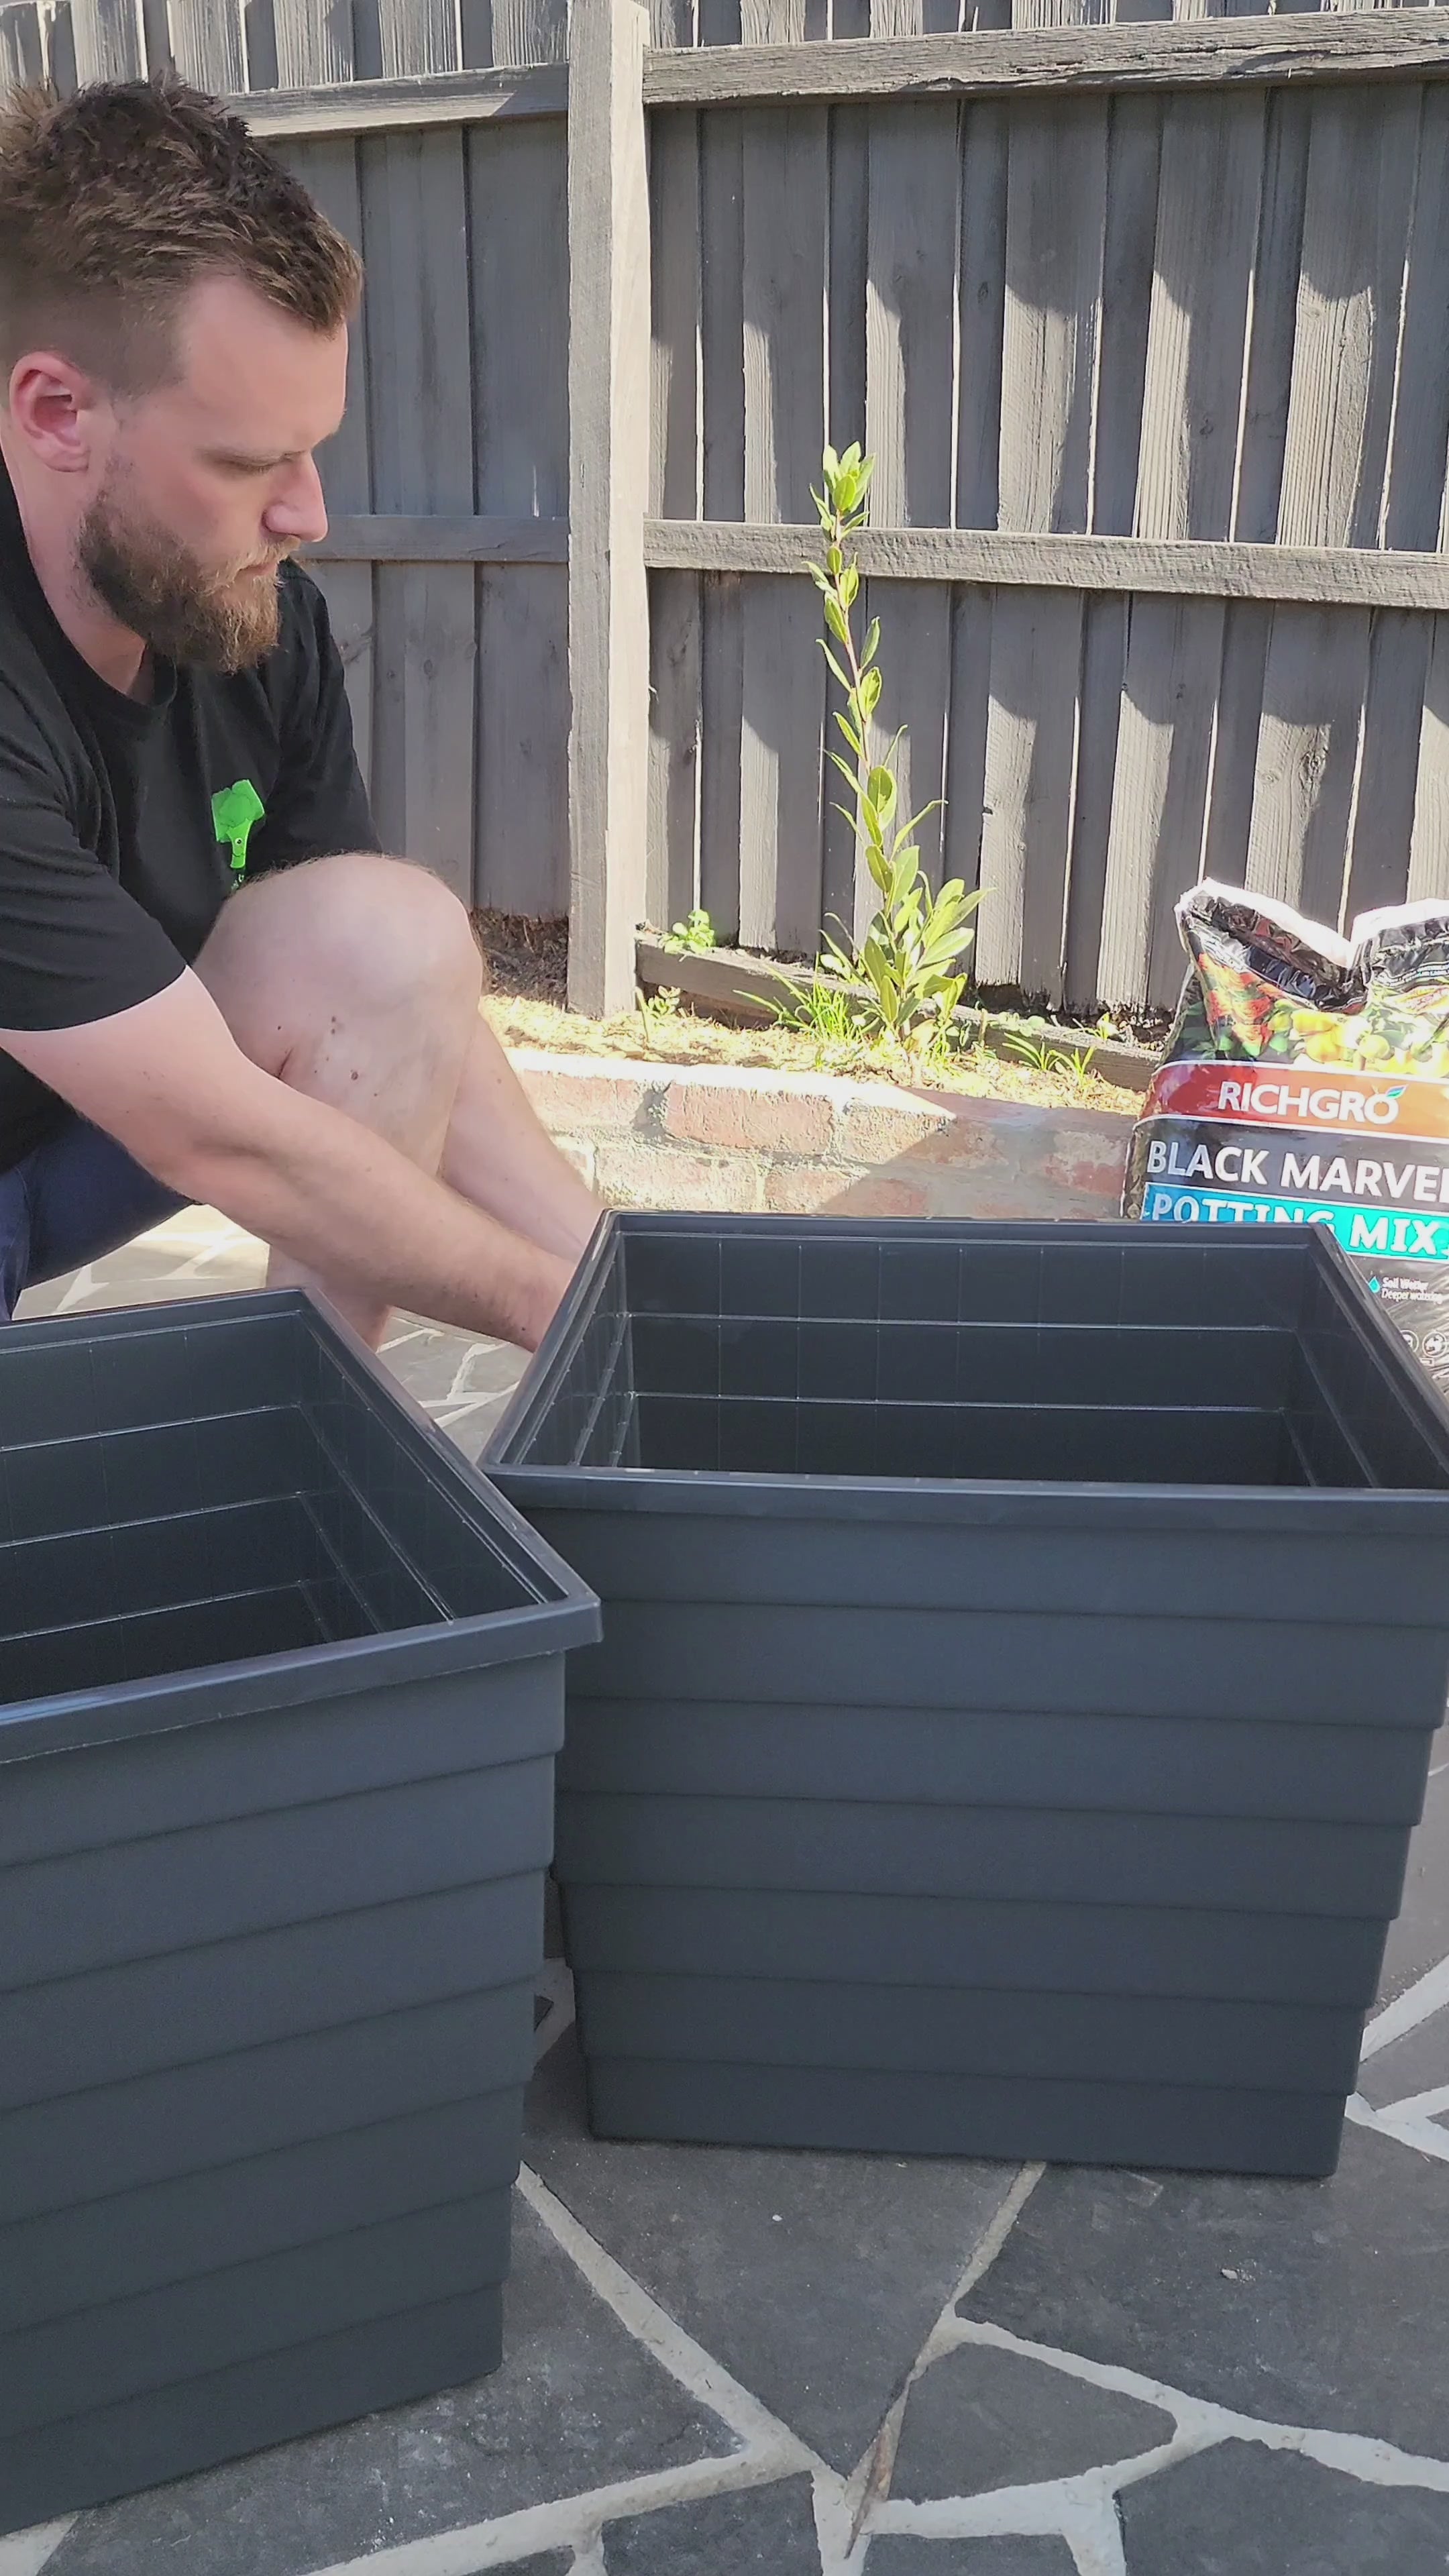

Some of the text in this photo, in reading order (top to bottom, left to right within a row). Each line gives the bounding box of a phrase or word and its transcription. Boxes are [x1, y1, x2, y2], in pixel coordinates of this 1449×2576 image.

[1218, 1081, 1399, 1124] RICHGRO
[1146, 1140, 1270, 1185] BLACK
[1349, 1214, 1440, 1255] MIX
